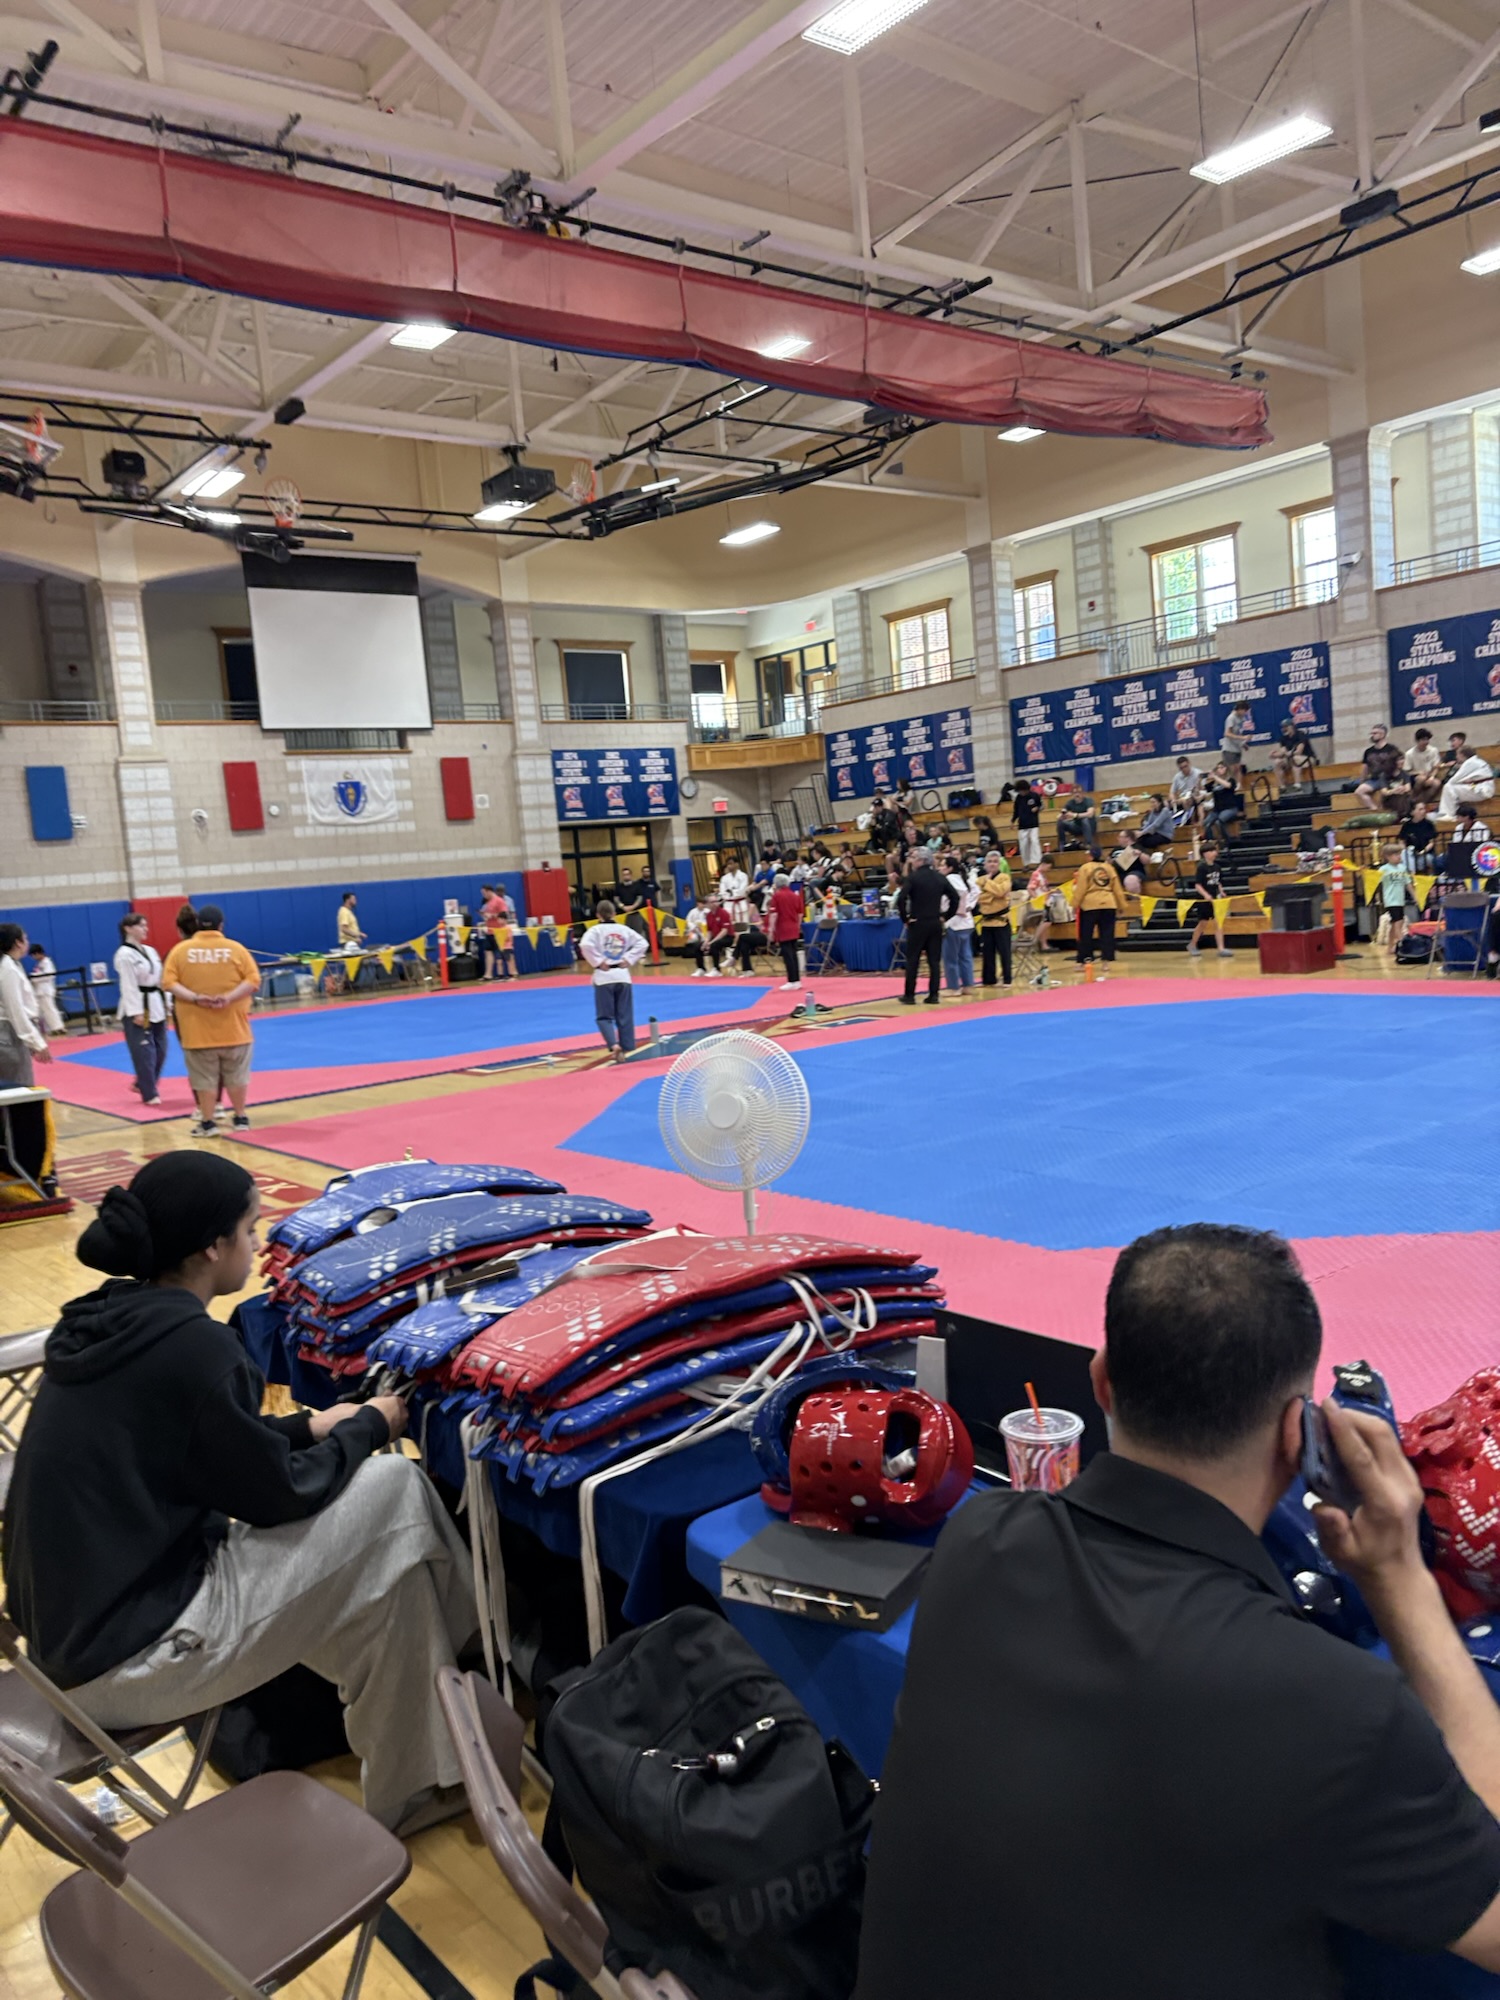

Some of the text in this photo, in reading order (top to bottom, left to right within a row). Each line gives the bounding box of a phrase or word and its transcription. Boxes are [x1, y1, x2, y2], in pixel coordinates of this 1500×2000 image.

[1413, 630, 1439, 646] 2023
[1291, 647, 1313, 661] 2023
[1410, 641, 1443, 657] STATE
[1281, 657, 1318, 674] DIVISION
[1398, 650, 1457, 671] CHAMPIONS
[1221, 667, 1264, 684] DIVISION 2
[1289, 668, 1317, 682] STATE
[1229, 679, 1256, 692] STATE
[1278, 677, 1328, 695] CHAMPIONS
[1174, 688, 1199, 700] STATE
[1220, 688, 1266, 704] CHAMPIONS
[1122, 702, 1149, 715] STATE
[1165, 696, 1209, 712] CHAMPIONS
[187, 948, 232, 964] STAFF
[692, 1848, 858, 1942] BURBE
